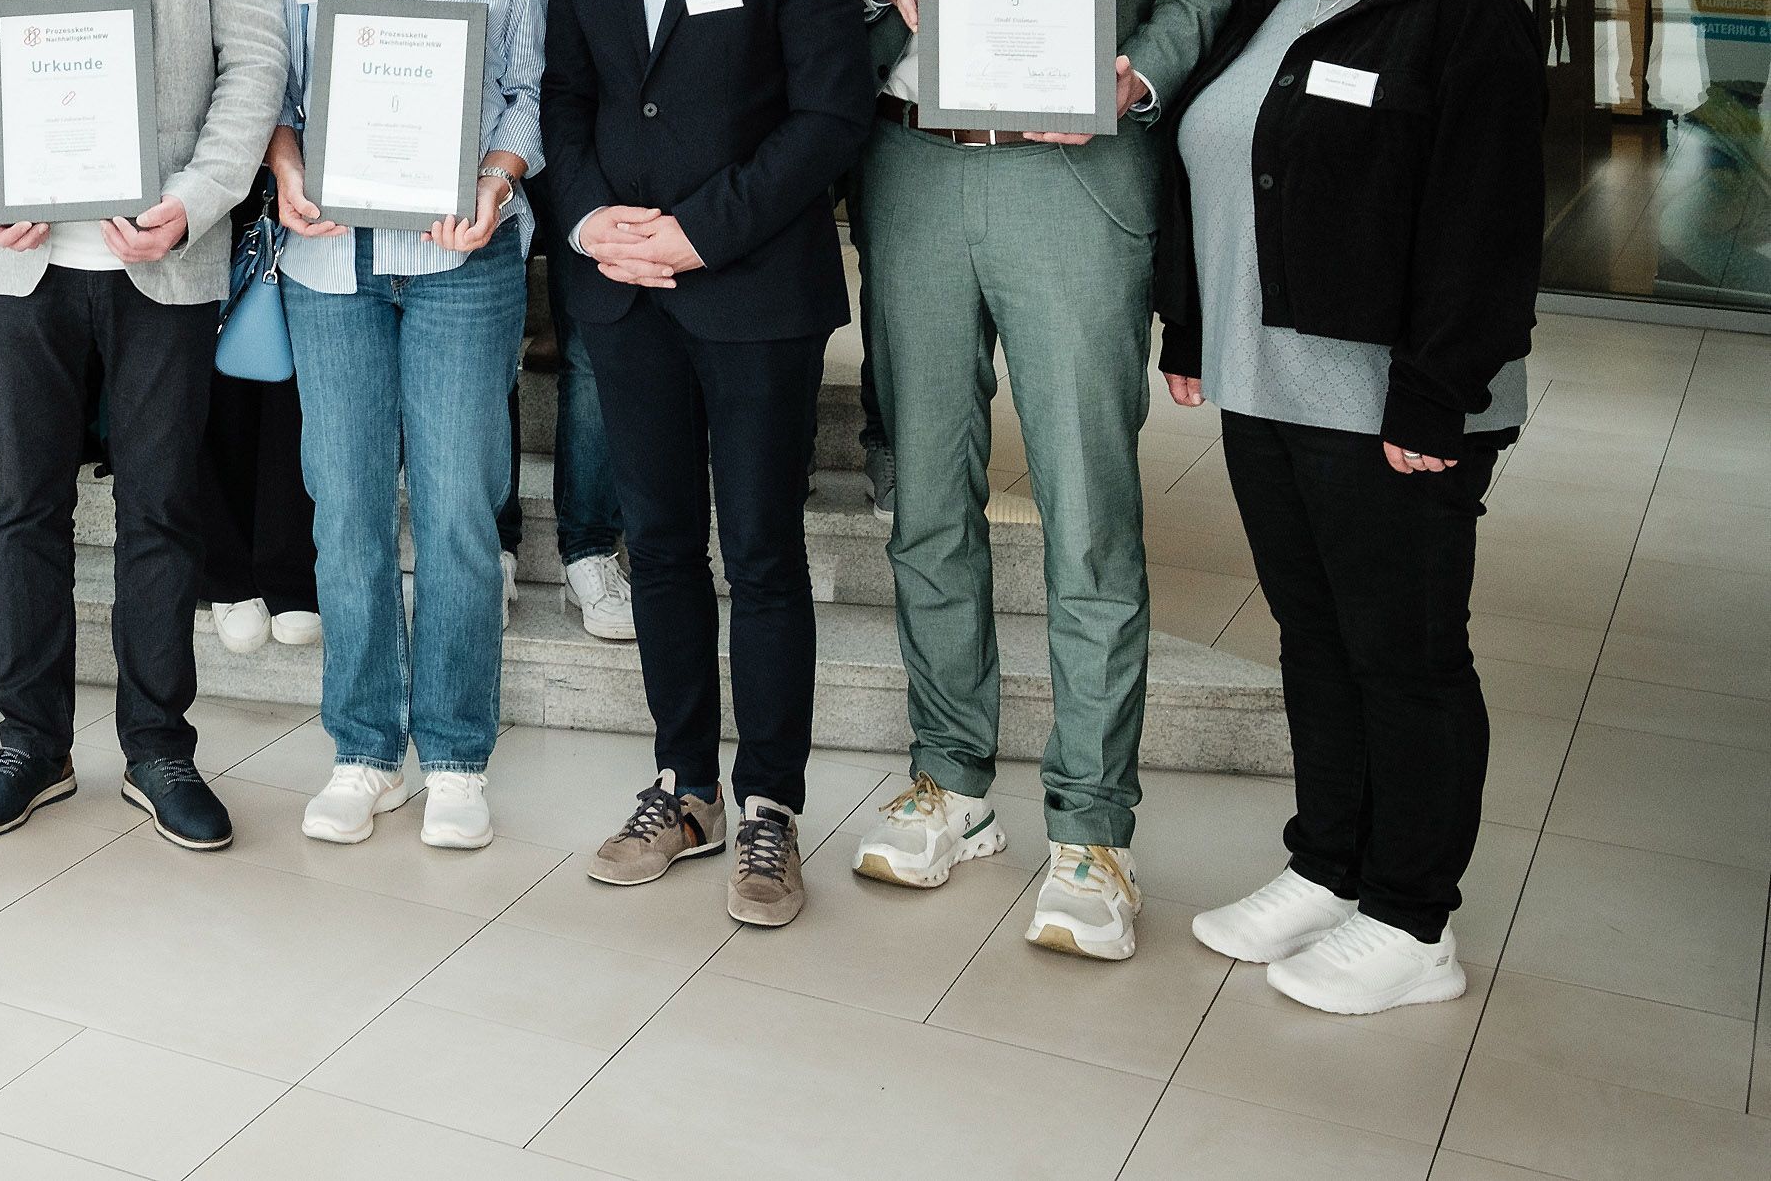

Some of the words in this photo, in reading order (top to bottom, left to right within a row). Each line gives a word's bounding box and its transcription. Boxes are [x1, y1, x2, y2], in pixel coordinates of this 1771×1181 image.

[45, 26, 94, 35] Prozesskette
[380, 30, 428, 39] Prozesskette
[45, 34, 91, 43] Nachhaltigkeit
[31, 58, 104, 73] Urkunde
[362, 62, 434, 78] Urkunde
